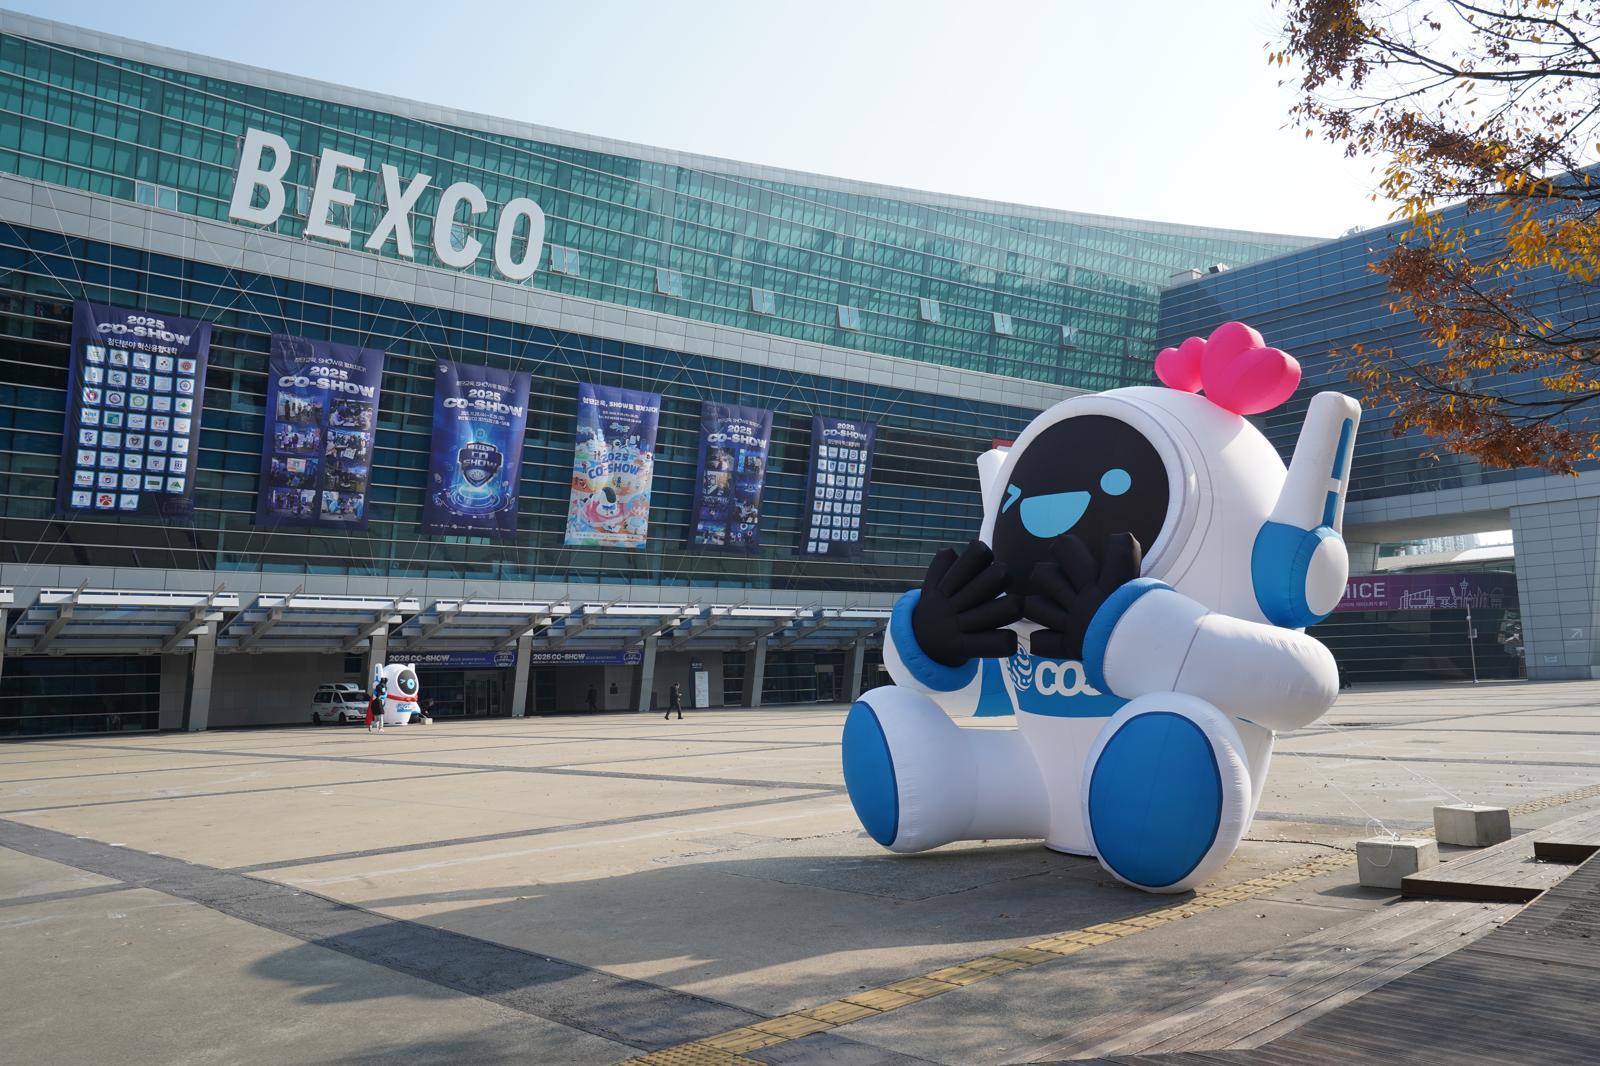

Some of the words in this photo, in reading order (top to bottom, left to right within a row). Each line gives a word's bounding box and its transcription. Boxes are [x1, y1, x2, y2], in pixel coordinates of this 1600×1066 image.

[228, 127, 546, 280] BEXCO
[127, 315, 165, 329] 2025
[97, 322, 191, 346] CO-SHOW
[309, 366, 349, 380] 2025
[278, 375, 375, 398] CO-SHOW
[468, 388, 501, 402] 2025
[443, 397, 523, 417] CO-SHOW
[727, 424, 752, 435] 2025
[837, 423, 855, 431] 2025
[707, 433, 767, 449] CO-SHOW
[823, 429, 867, 440] CO-SHOW
[601, 452, 629, 463] 2025
[588, 463, 640, 479] CO-SHOW
[410, 654, 450, 662] CO-SHOW
